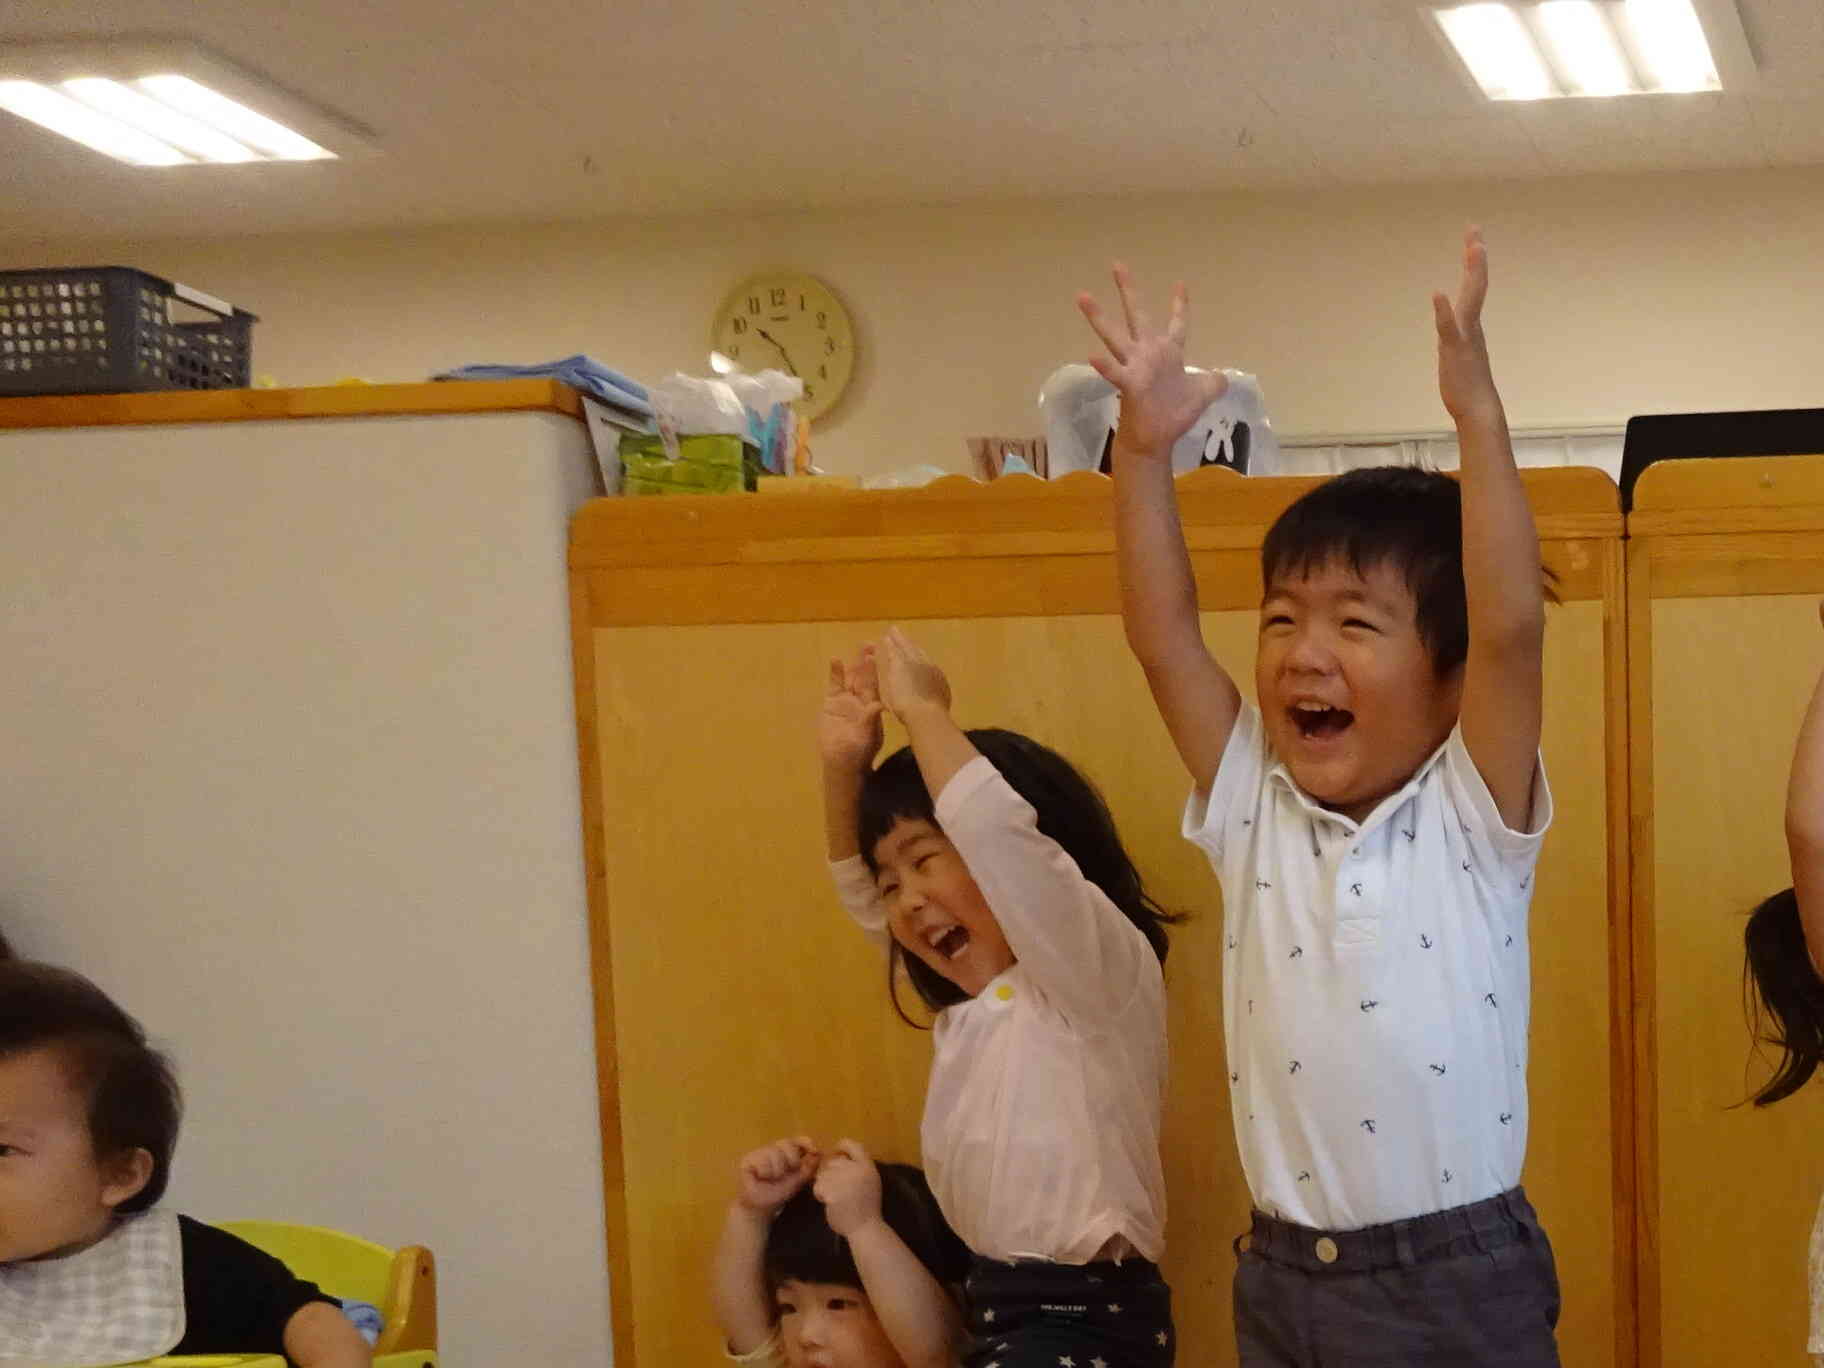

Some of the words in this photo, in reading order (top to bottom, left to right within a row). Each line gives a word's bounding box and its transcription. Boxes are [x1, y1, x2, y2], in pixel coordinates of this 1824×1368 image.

[748, 297, 761, 315] 11
[769, 288, 785, 306] 12
[799, 294, 805, 312] 1
[733, 316, 747, 334] 10
[816, 311, 826, 330] 2
[825, 336, 834, 356] 3
[804, 385, 814, 402] 5
